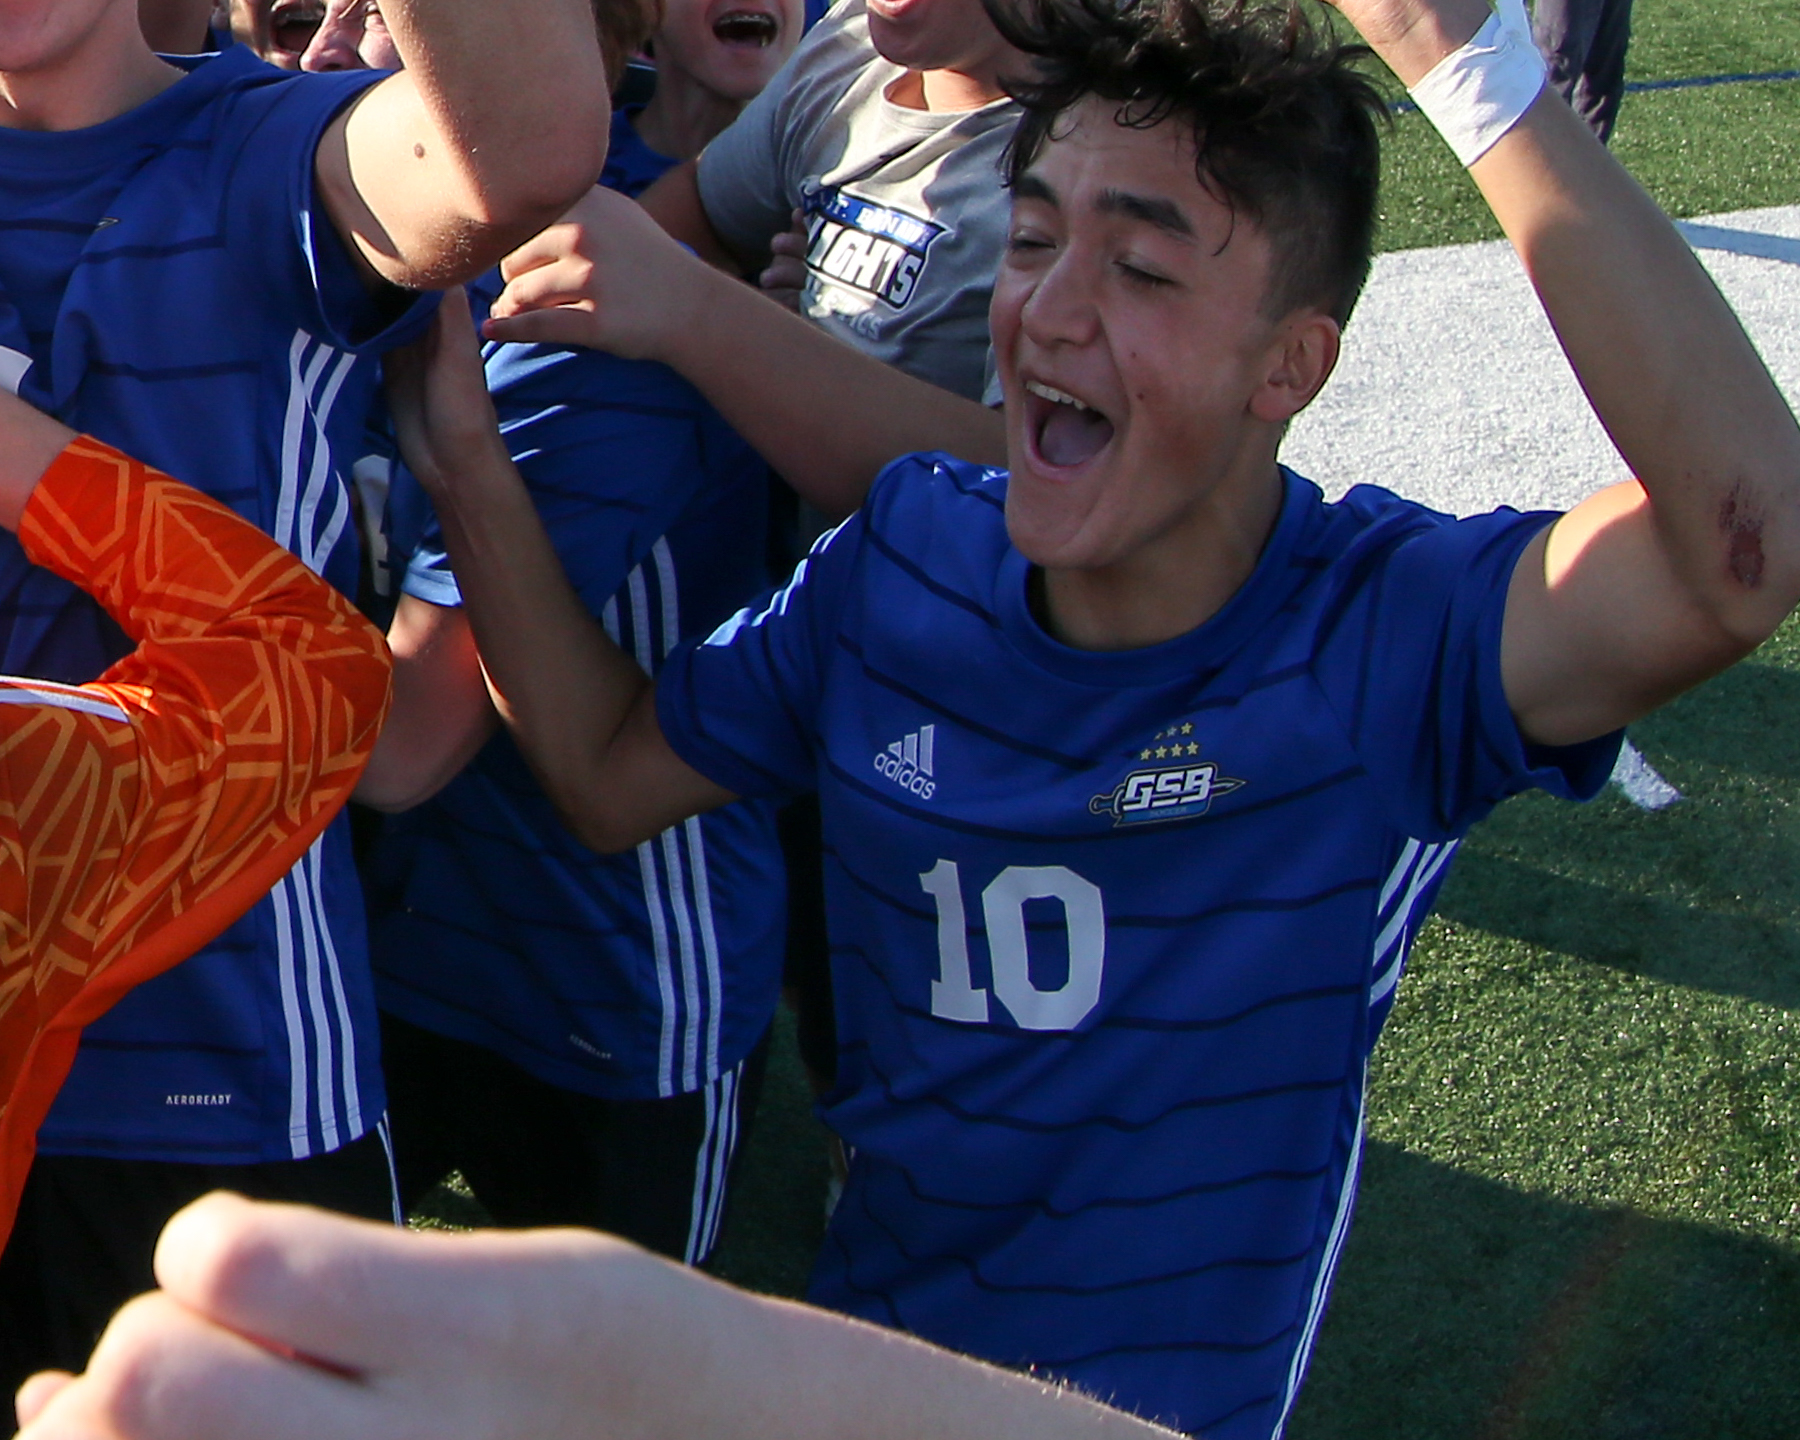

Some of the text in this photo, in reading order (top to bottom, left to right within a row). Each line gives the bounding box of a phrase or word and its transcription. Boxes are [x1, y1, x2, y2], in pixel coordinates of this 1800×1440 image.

[873, 752, 936, 800] adidas
[1122, 766, 1214, 811] GSB
[918, 858, 1106, 1031] 10
[165, 1093, 233, 1105] AEROREADY
